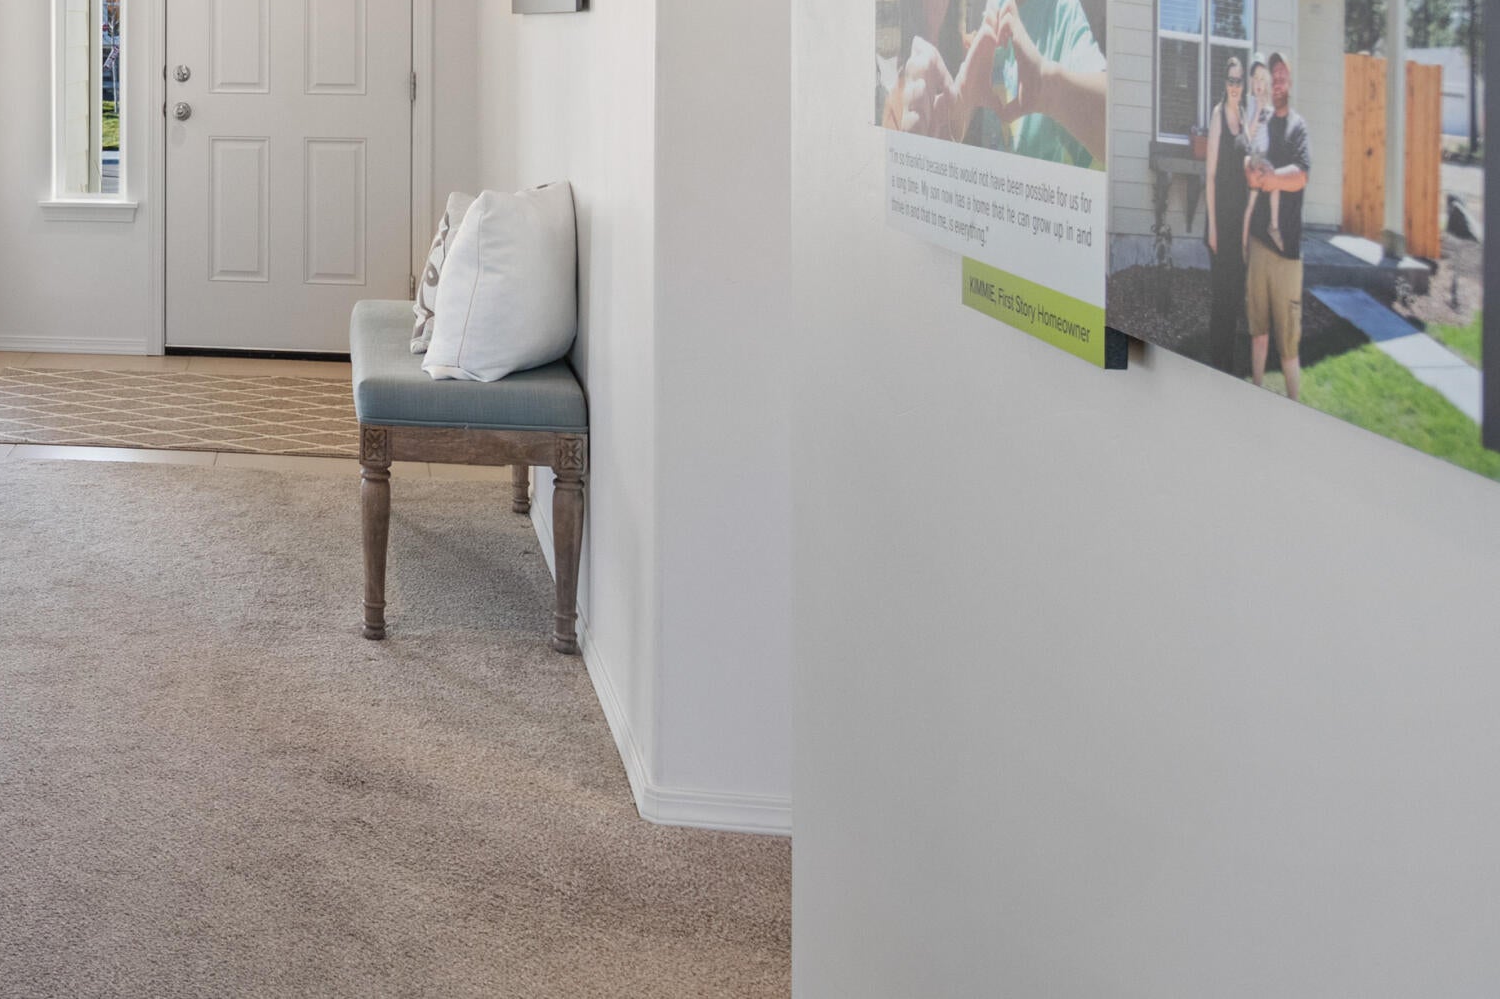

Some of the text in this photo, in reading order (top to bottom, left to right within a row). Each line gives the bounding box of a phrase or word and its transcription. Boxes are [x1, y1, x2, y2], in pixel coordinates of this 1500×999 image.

[990, 170, 1005, 192] have
[1007, 176, 1023, 196] been
[1025, 183, 1055, 205] possible
[1057, 186, 1067, 208] for
[1069, 194, 1079, 211] us
[1081, 191, 1092, 214] for
[991, 200, 1004, 220] that
[1007, 203, 1015, 224] he
[1018, 211, 1030, 229] can
[1032, 215, 1051, 236] grow
[1054, 222, 1063, 242] up
[1066, 221, 1073, 241] in
[1076, 226, 1092, 247] and
[998, 287, 1014, 311] First
[1015, 295, 1036, 324] Story
[1038, 303, 1090, 343] Homeowner
